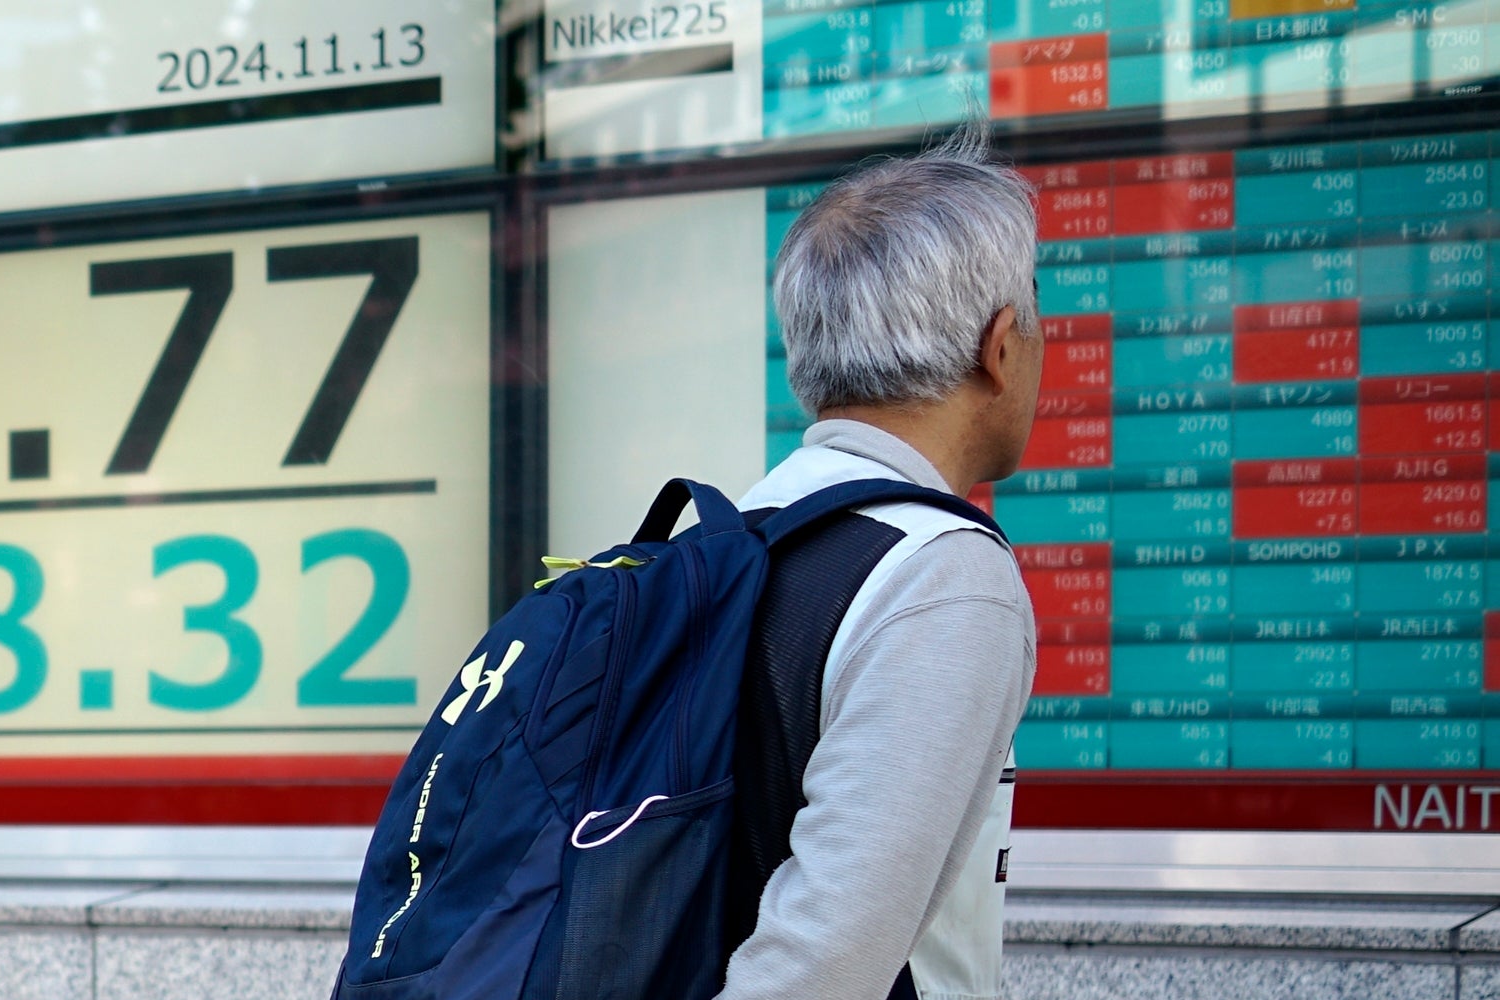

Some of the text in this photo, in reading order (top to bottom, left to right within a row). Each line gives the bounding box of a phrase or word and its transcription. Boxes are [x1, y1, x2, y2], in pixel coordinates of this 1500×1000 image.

[1395, 7, 1447, 26] SMC
[553, 5, 728, 49] Nikkei225
[156, 23, 427, 94] 2024.11.13
[1050, 65, 1103, 84] 1532.5
[1068, 88, 1103, 106] +6.5
[1444, 85, 1483, 97] SHARP
[1312, 173, 1354, 191] 4306
[1426, 164, 1484, 184] 2554.0
[1188, 182, 1228, 201] 8679
[1440, 190, 1484, 209] -23.0
[1328, 199, 1354, 216] -35
[1312, 252, 1353, 271] 9404
[1433, 270, 1483, 289] -1400
[1269, 306, 1323, 327] 日産自
[1307, 331, 1354, 348] 417.7
[1426, 325, 1482, 343] 1909.5
[1317, 357, 1354, 374] +1.9
[1448, 352, 1482, 369] -3.5
[1395, 380, 1450, 399] リコー
[1138, 392, 1206, 411] HOYA
[1178, 416, 1228, 435] 20770
[1434, 430, 1482, 448] +12.5
[1297, 488, 1352, 507] 1227.0
[1422, 485, 1480, 503] 2429.0
[1316, 514, 1352, 531] +7.5
[1433, 510, 1480, 528] +16.0
[1249, 542, 1341, 561] SOMPOHD
[1396, 539, 1447, 558] JPX
[1424, 563, 1480, 581] 1874.5
[1380, 618, 1459, 638] JR西日本
[1421, 644, 1479, 662] 2717.5
[1374, 783, 1500, 830] NAIT
[371, 752, 444, 959] UNDER ARMOUR
